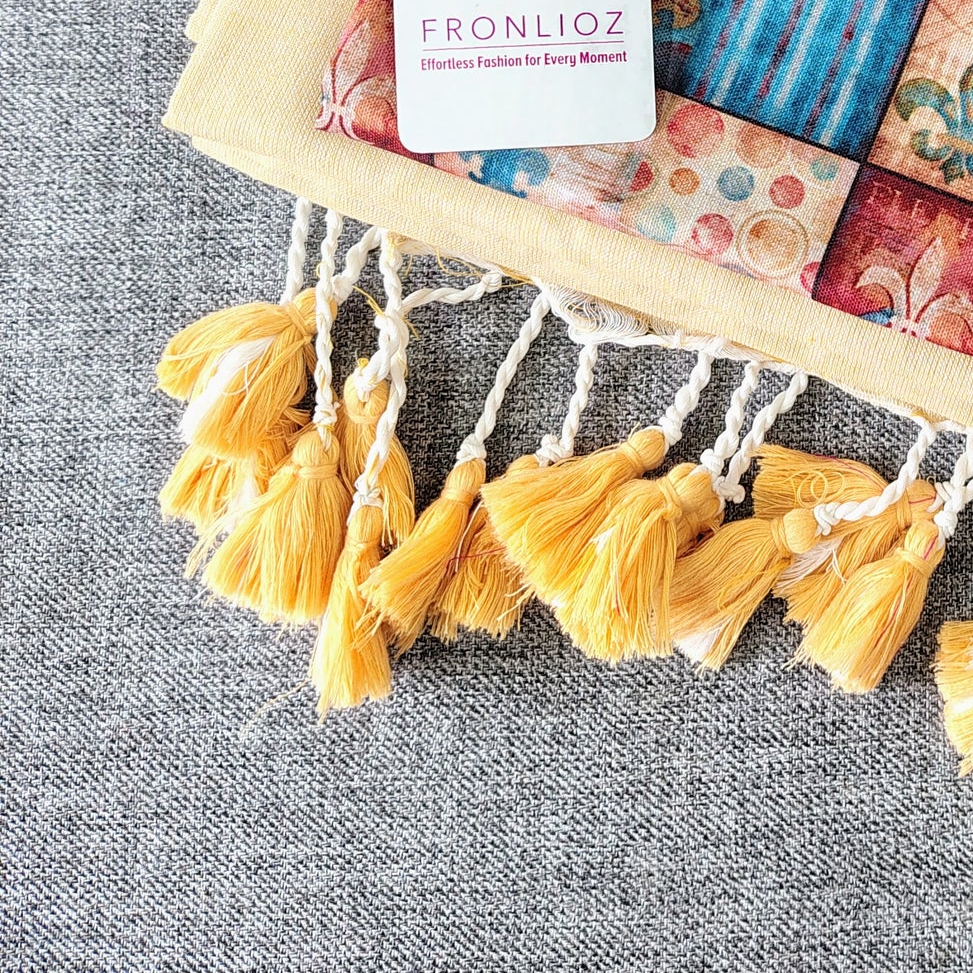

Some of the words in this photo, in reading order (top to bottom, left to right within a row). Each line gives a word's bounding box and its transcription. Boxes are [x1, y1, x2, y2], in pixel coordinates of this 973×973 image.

[422, 11, 624, 42] FRONLIOZ
[421, 57, 475, 71] Effortless
[477, 54, 522, 68] Fashion
[525, 54, 541, 66] for
[544, 52, 576, 68] Every
[579, 50, 627, 64] Moment
